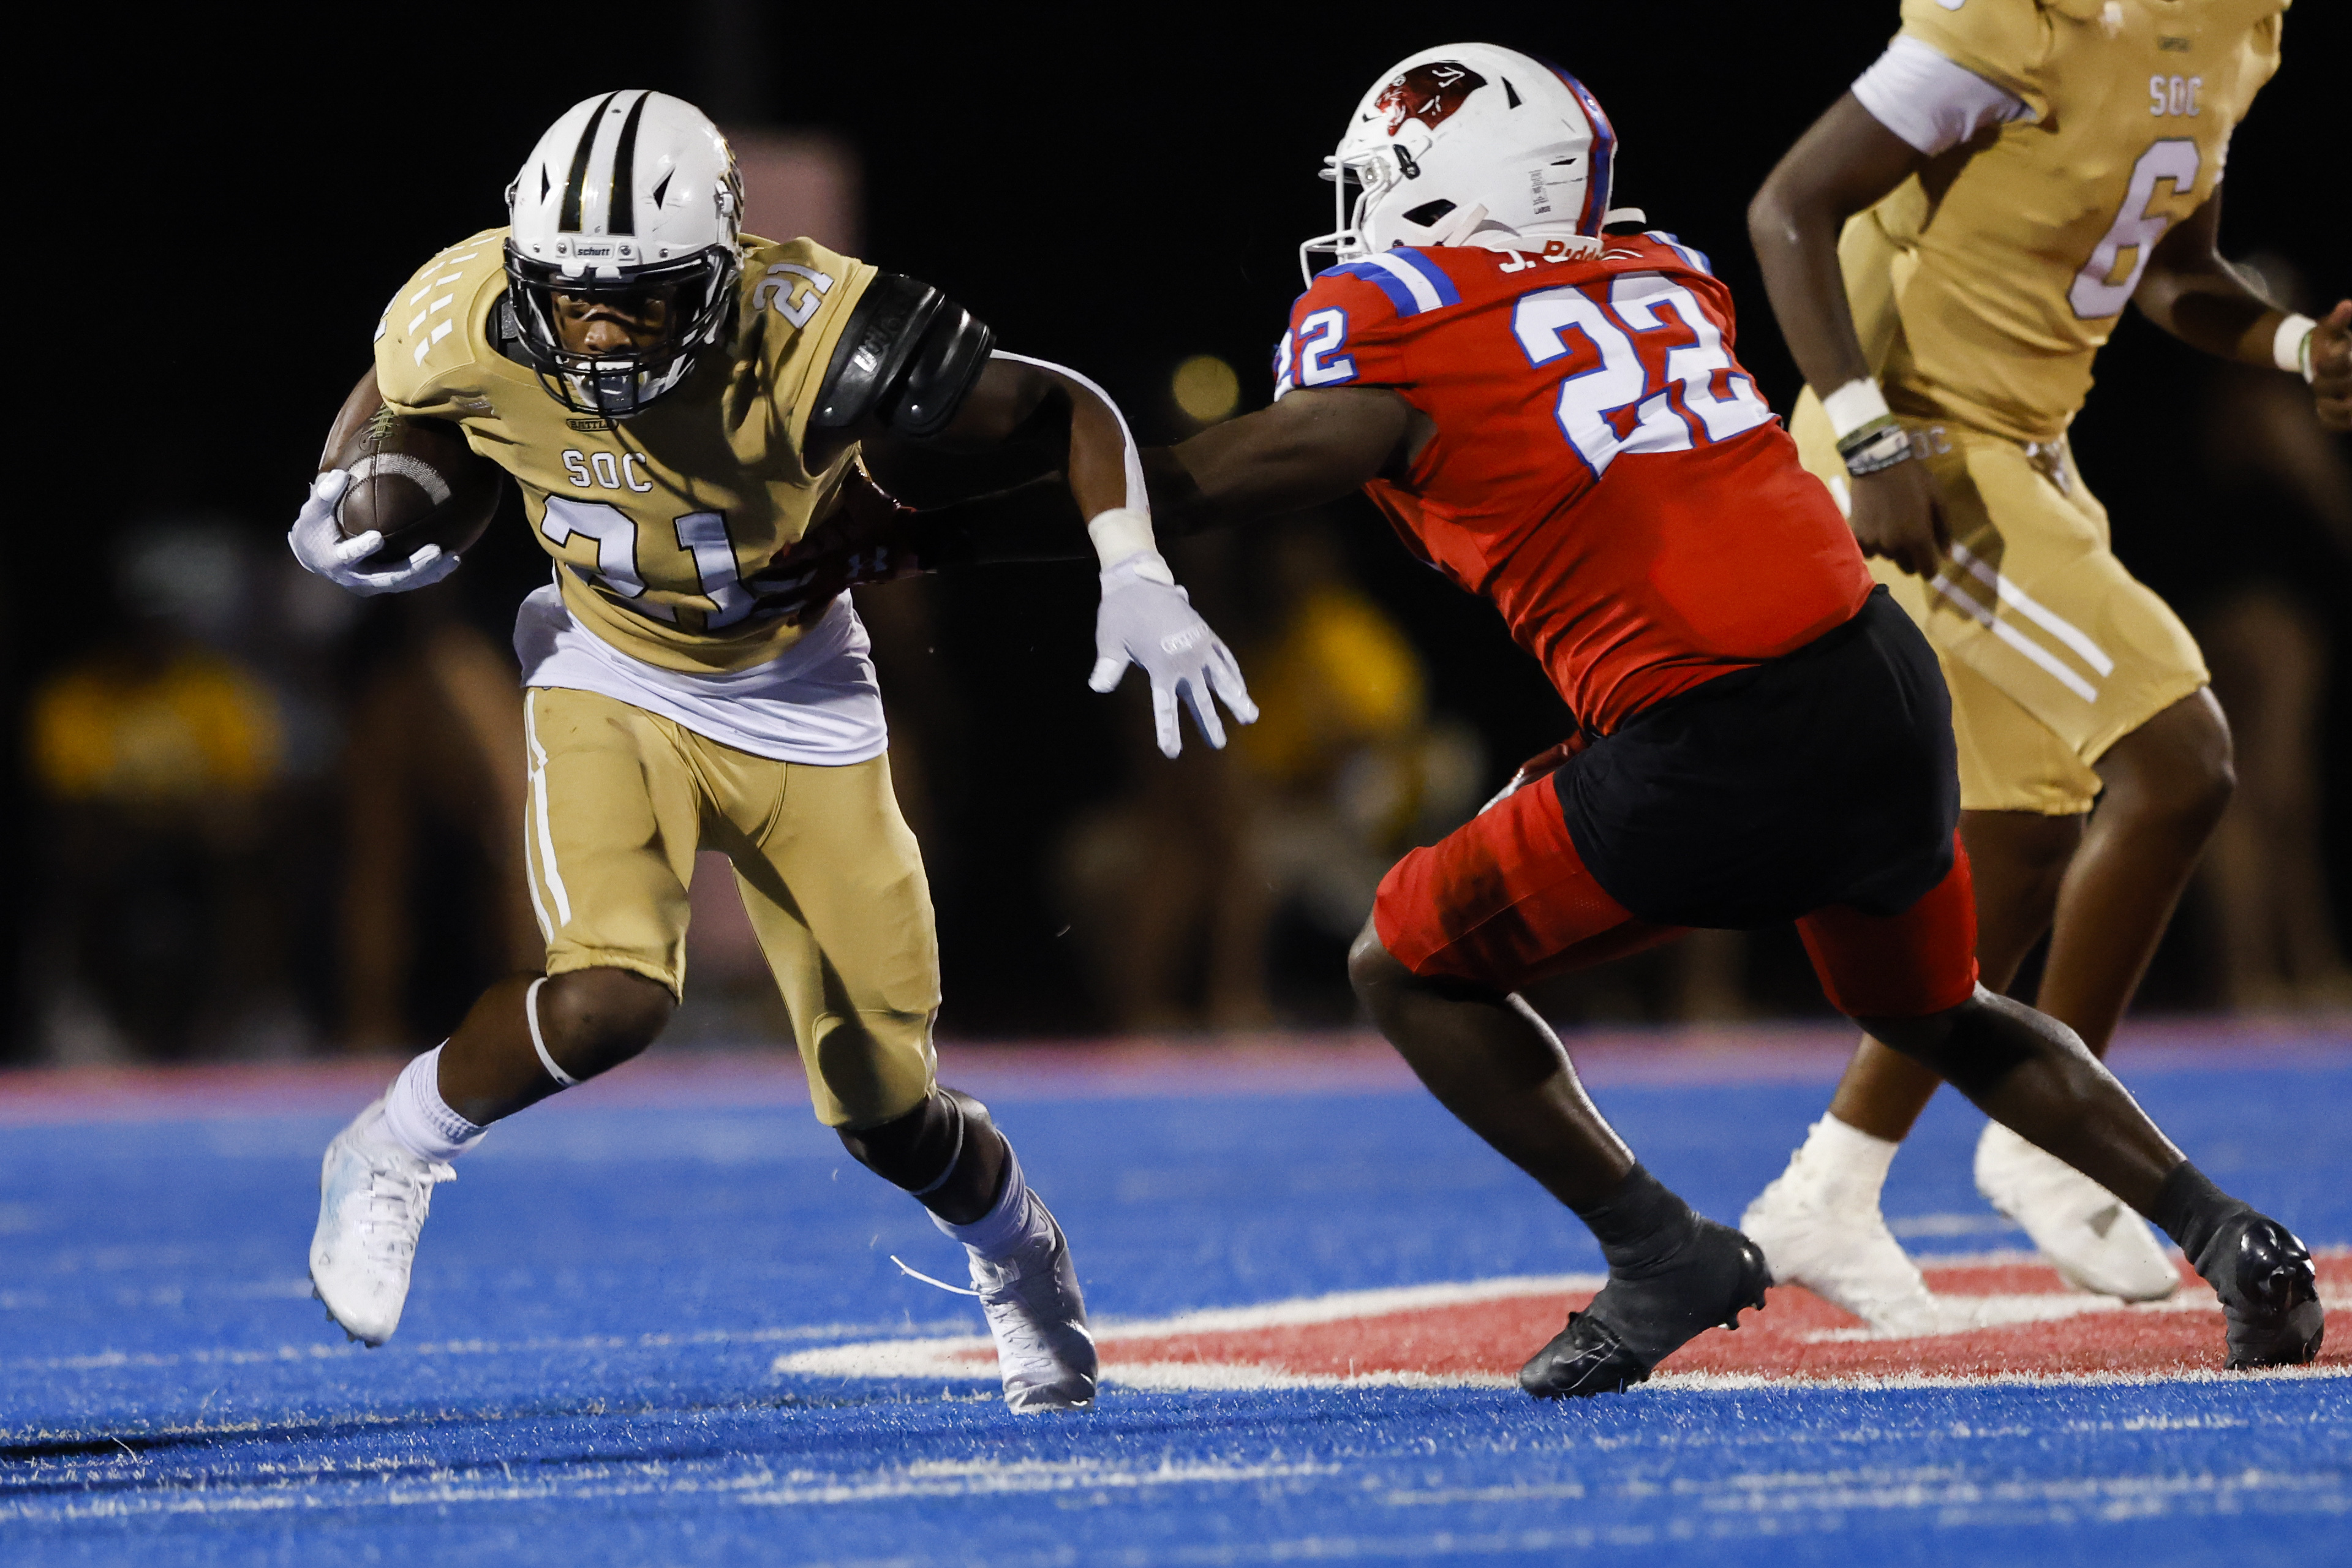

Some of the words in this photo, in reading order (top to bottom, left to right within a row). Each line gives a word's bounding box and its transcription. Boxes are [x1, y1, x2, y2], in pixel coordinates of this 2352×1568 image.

[2149, 75, 2203, 116] SOC
[2066, 138, 2201, 319] 6
[753, 263, 834, 329] 21
[1511, 270, 1778, 484] 22
[570, 420, 609, 429] BATTL
[560, 449, 654, 492] SOC
